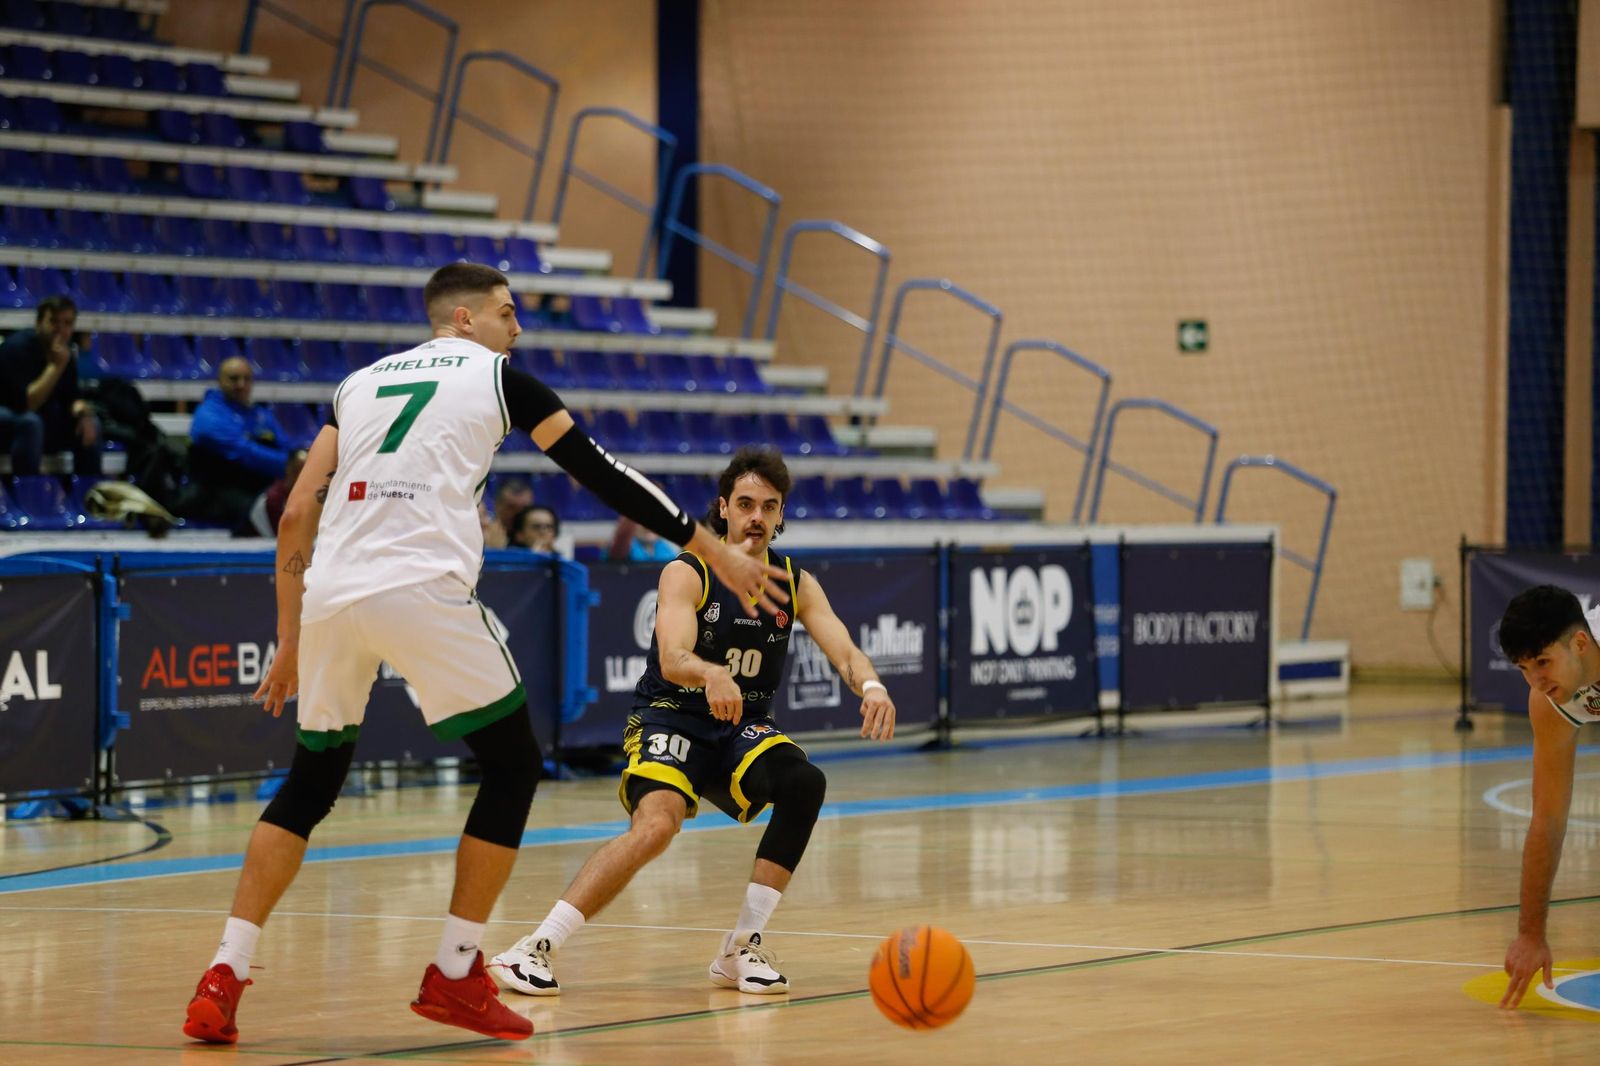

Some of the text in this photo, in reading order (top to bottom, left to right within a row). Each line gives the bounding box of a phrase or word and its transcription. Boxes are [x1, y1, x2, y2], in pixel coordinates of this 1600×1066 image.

[370, 355, 470, 375] SHELIST
[375, 380, 440, 455] 7
[367, 490, 415, 501] de Huesca
[368, 479, 432, 493] Ayuntamiento
[970, 564, 1073, 656] NOP
[1132, 612, 1182, 645] BODY
[1184, 610, 1259, 645] FACTORY
[725, 648, 763, 678] 30
[970, 660, 997, 685] NOT
[1027, 655, 1077, 683] PRINTING
[648, 733, 691, 763] 30
